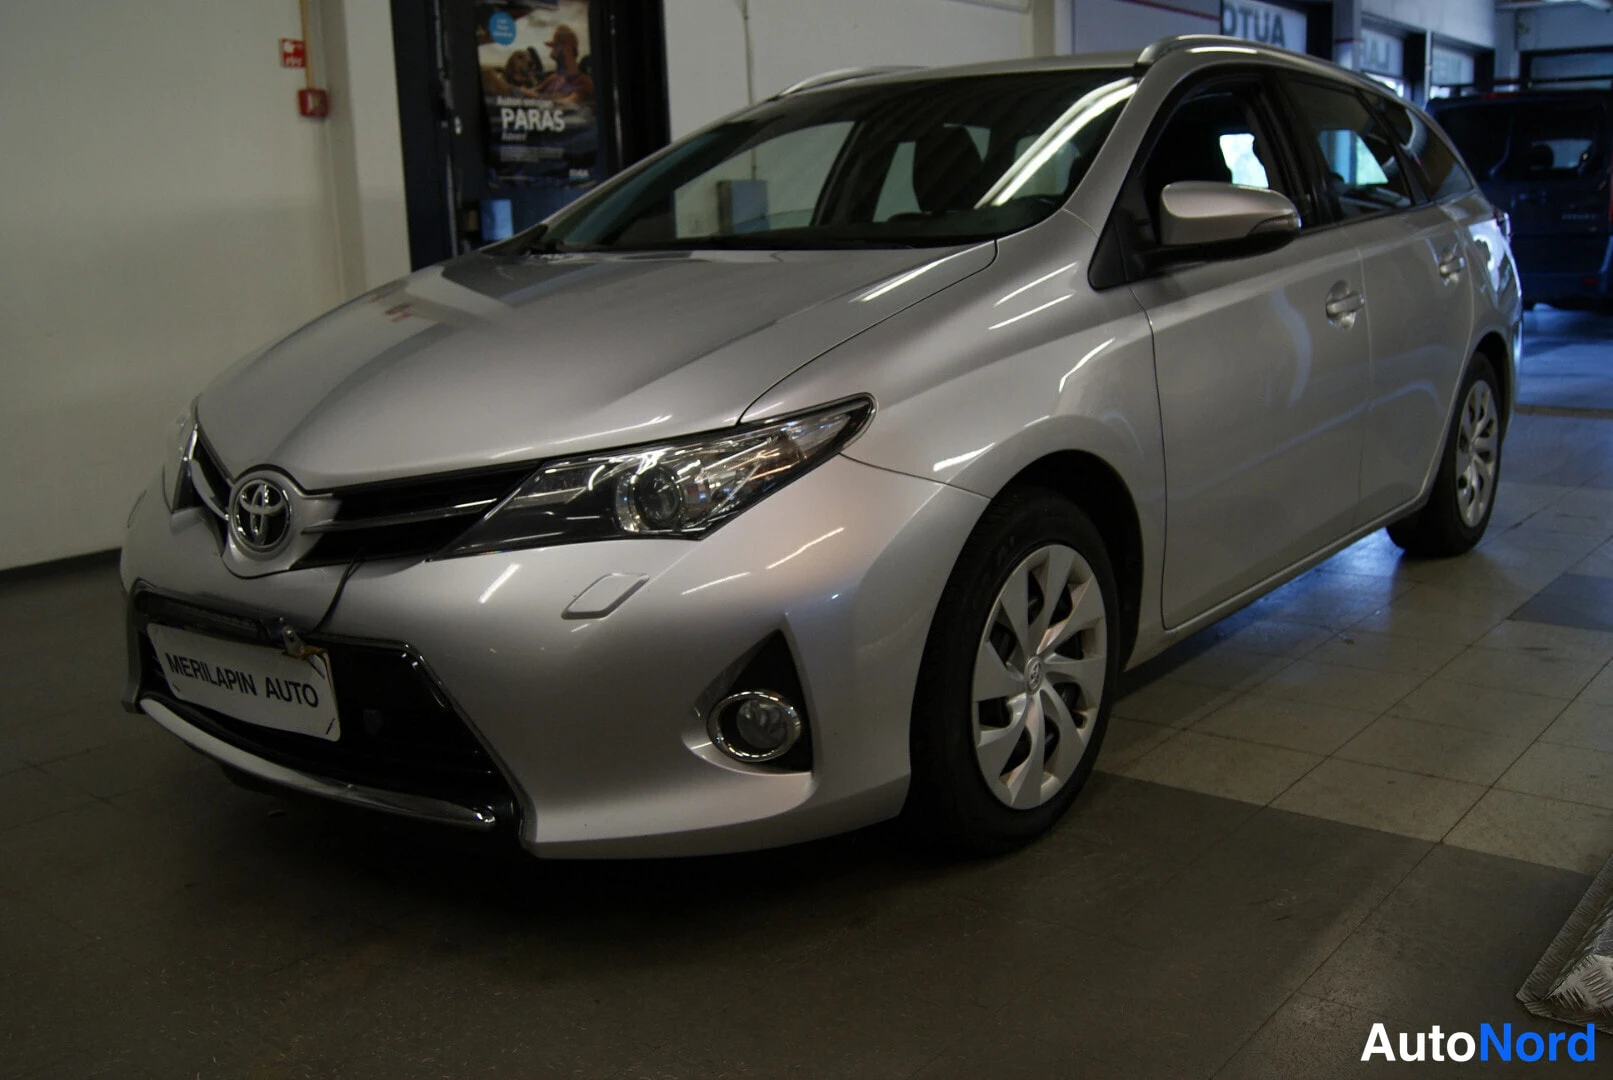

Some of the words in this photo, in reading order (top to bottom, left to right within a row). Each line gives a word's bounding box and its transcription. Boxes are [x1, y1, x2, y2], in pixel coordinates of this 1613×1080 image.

[502, 108, 566, 132] PARAS
[165, 653, 258, 696] MERILAPIN
[266, 677, 319, 708] AUTO
